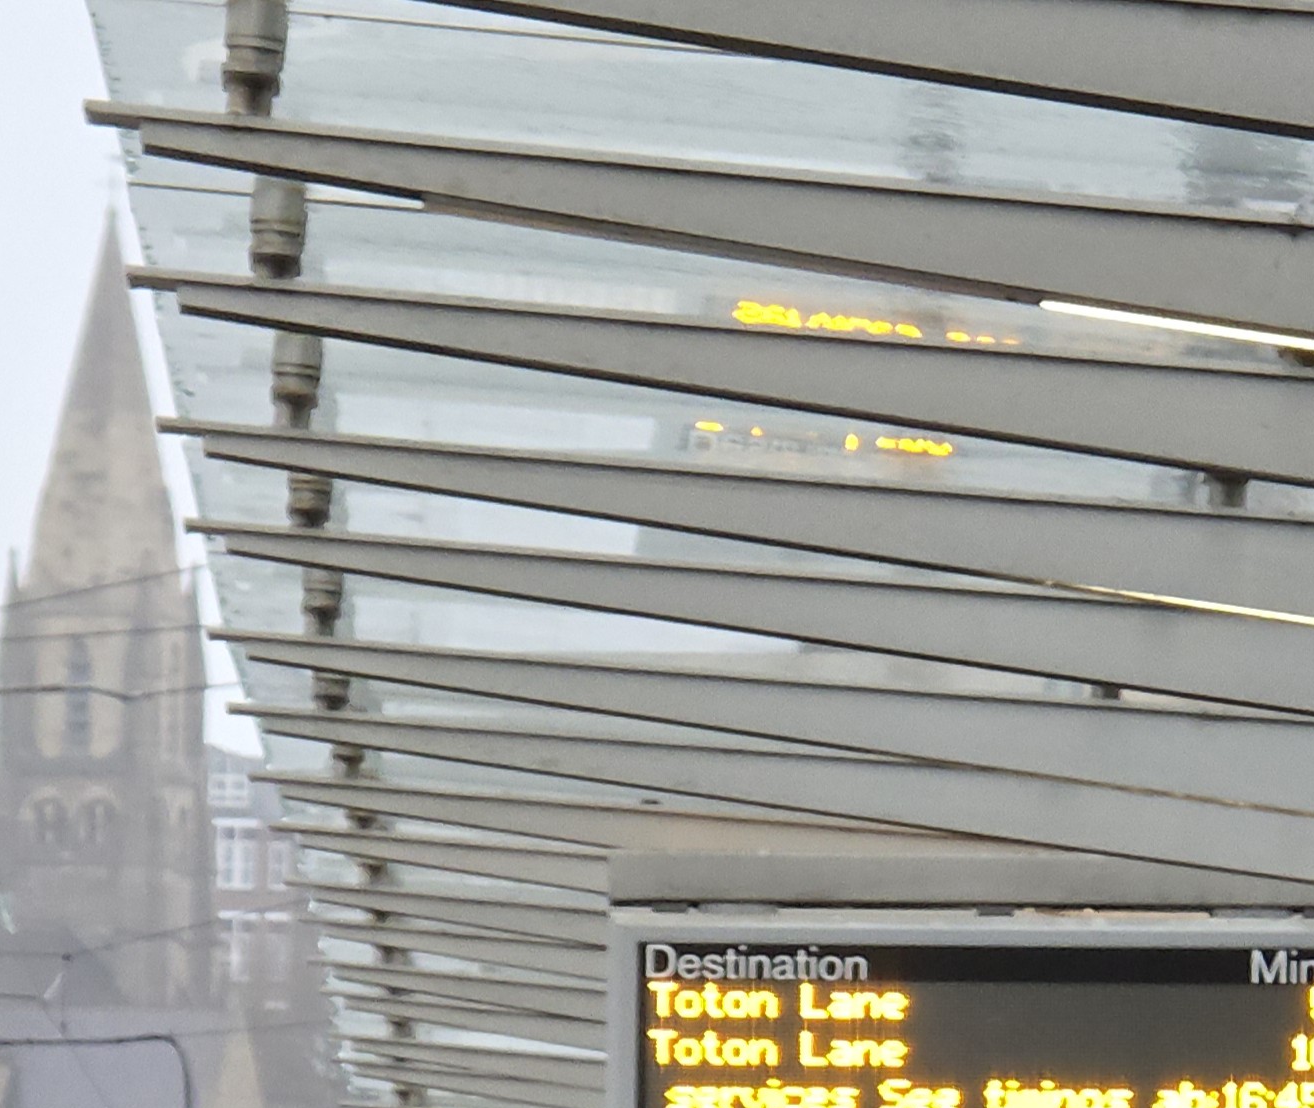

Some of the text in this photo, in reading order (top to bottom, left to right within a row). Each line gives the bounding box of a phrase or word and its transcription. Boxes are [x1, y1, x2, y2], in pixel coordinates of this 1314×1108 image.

[645, 944, 869, 981] Destination
[647, 981, 780, 1019] Toton
[799, 982, 910, 1021] Lane
[647, 1029, 780, 1067] Toton
[799, 1030, 910, 1068] Lane
